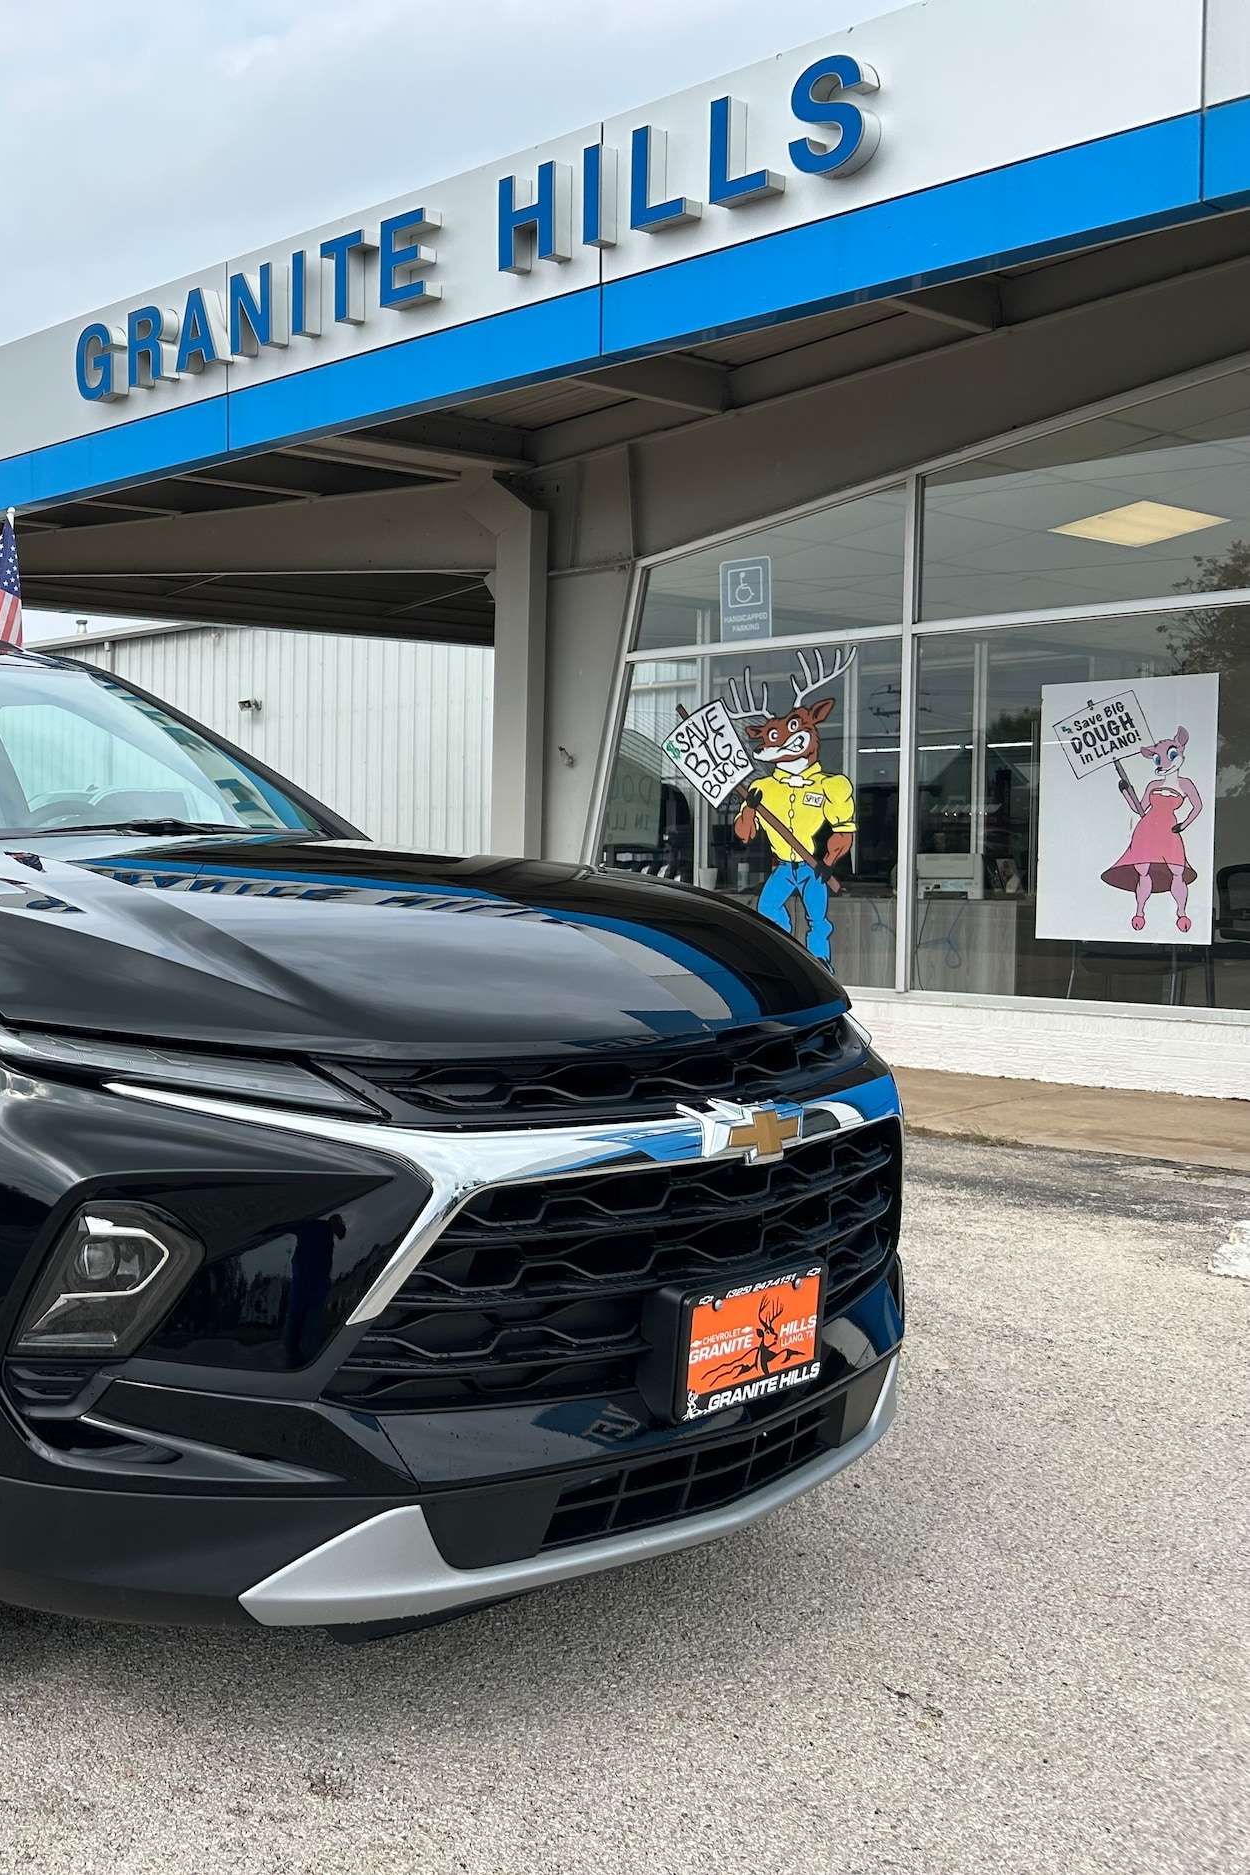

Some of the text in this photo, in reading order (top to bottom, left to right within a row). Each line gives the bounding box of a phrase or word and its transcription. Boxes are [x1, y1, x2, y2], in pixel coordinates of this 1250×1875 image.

[76, 54, 879, 401] GRANITE HILLS
[724, 612, 768, 623] HANDICAPPED
[732, 623, 760, 632] PARKING
[675, 707, 725, 752] SAVE
[1070, 712, 1136, 754] DOUGH
[1074, 713, 1103, 731] Save
[1103, 701, 1125, 718] BIG
[684, 732, 732, 778] BIG
[1080, 729, 1142, 765] in LLANO!
[702, 749, 749, 799] BUCKS
[805, 794, 822, 805] SPIKE
[726, 1273, 796, 1299] (325) 247-4151
[689, 1314, 817, 1364] GRANITE HILLS
[702, 1328, 741, 1344] CHEVROLET
[780, 1330, 815, 1347] LLANO, TX
[708, 1361, 820, 1411] GRANITE HILLS
